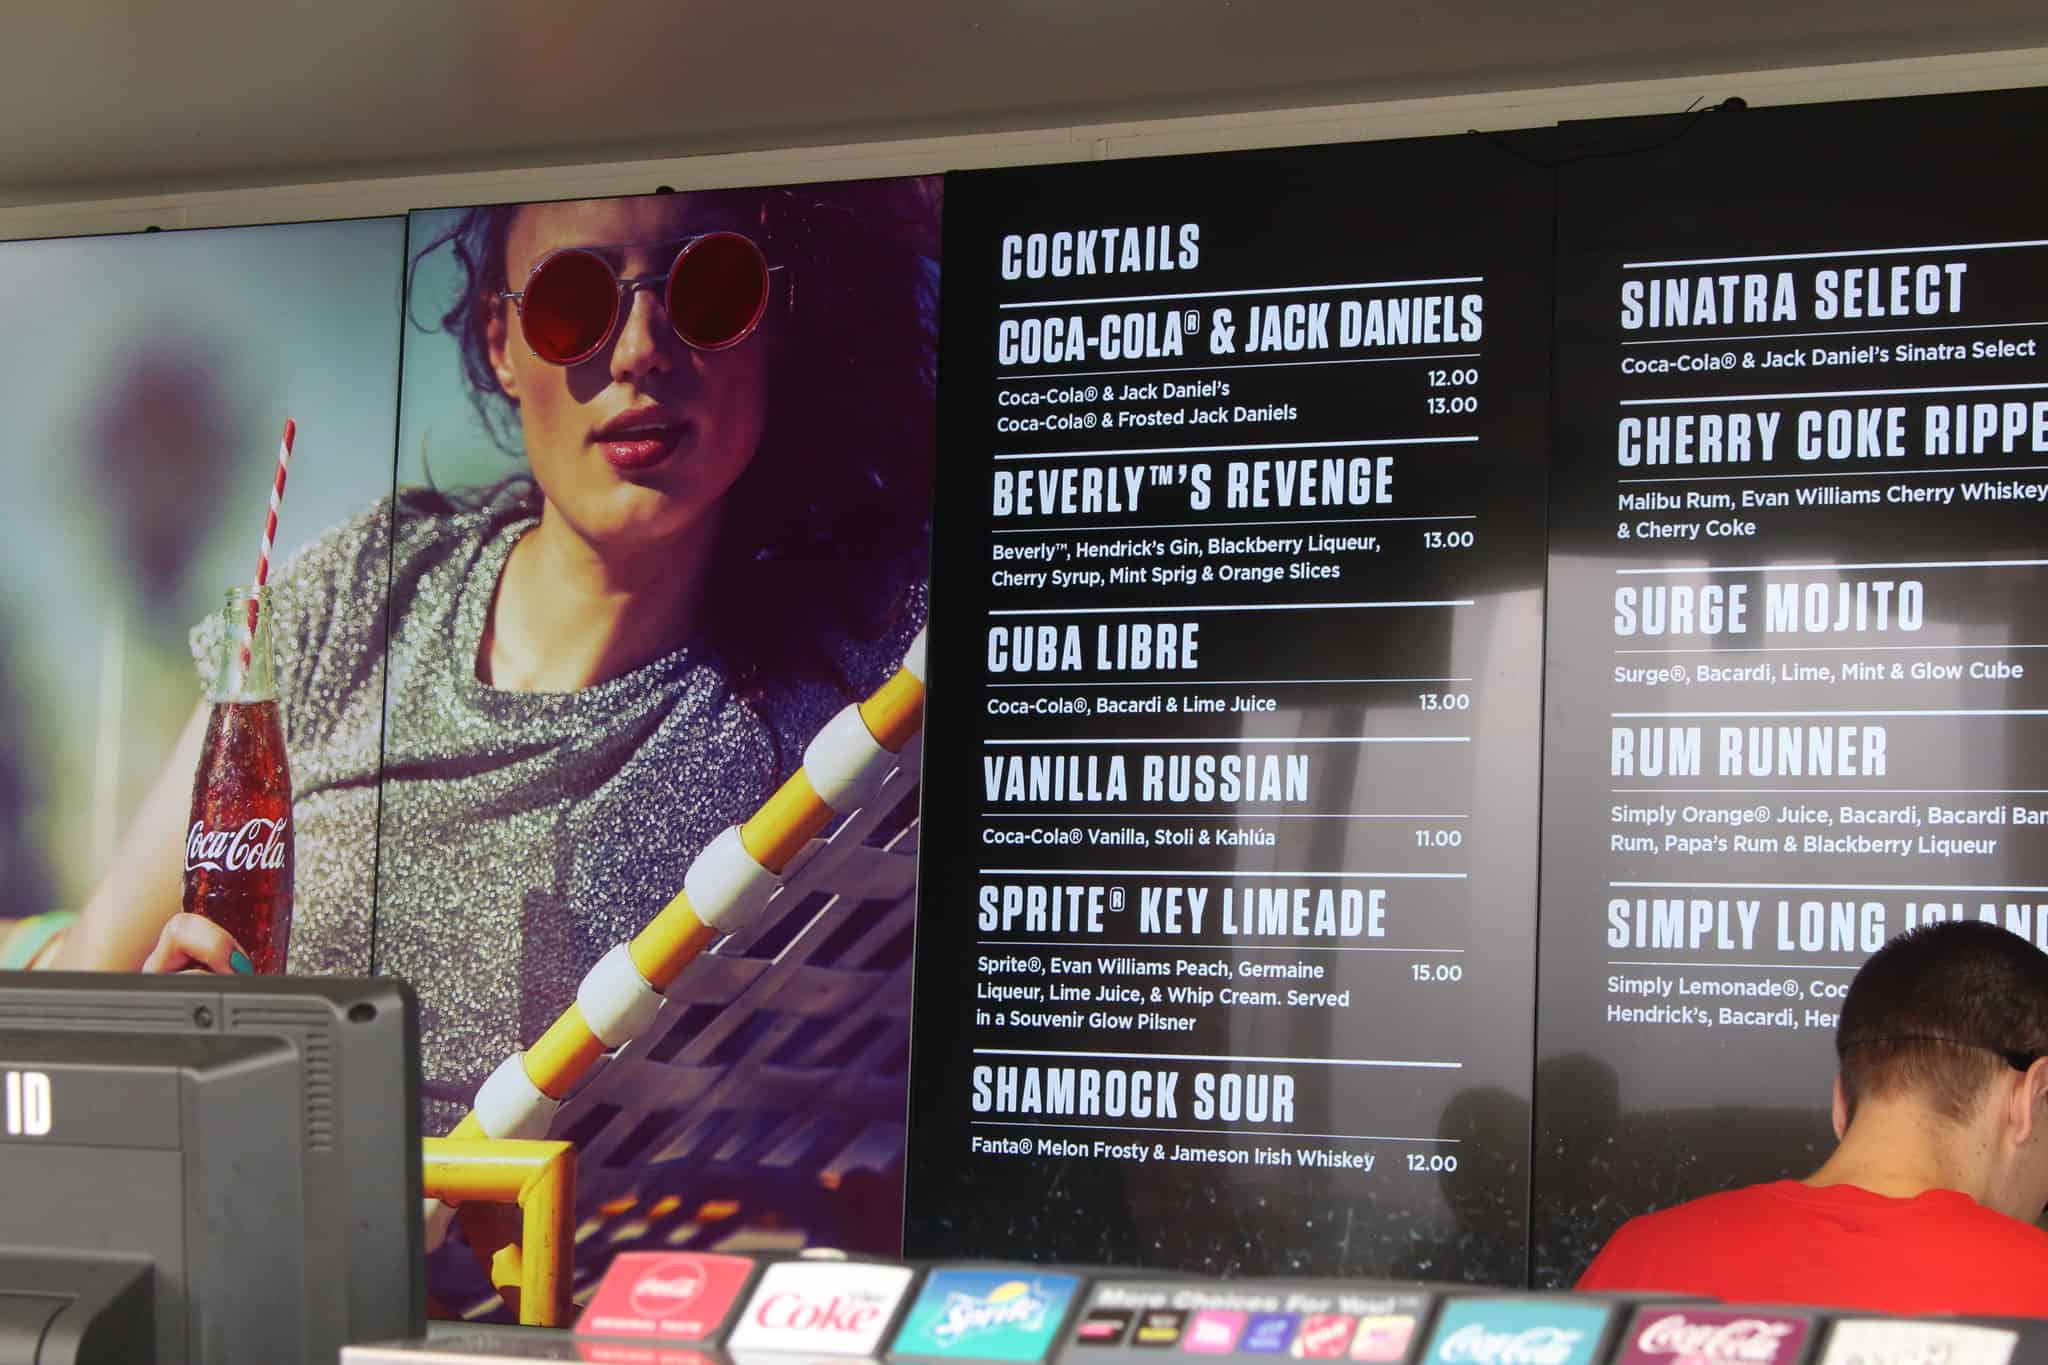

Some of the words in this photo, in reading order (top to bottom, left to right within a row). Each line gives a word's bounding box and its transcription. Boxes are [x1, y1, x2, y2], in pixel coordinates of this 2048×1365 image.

[1002, 224, 1200, 280] COCKTAILS
[1622, 273, 1797, 330] SINATRA
[1815, 263, 1967, 320] SELECT
[1210, 309, 1236, 355] &
[1245, 303, 1331, 353] JACK
[1340, 295, 1483, 348] DANIELS
[1622, 353, 1737, 374] Coca-Cola®
[1742, 352, 1755, 369] &
[1761, 350, 1806, 368] Jack
[1813, 346, 1889, 366] Daniel's
[1896, 344, 1966, 362] Sinatra
[1973, 340, 2036, 359] Select
[1429, 369, 1479, 387] 12.00
[999, 386, 1098, 406] Coca-Cola®
[1103, 386, 1115, 401] &
[1119, 384, 1158, 401] Jack
[1164, 381, 1230, 399] Daniel's
[1428, 397, 1478, 415] 13.00
[998, 413, 1097, 433] Coca-Cola®
[1102, 413, 1113, 428] &
[1119, 409, 1185, 428] Frosted
[1189, 407, 1229, 425] Jack
[1234, 404, 1297, 423] Daniels
[1619, 412, 1781, 467] CHERRY
[1798, 407, 1906, 461] COKE
[1926, 402, 2048, 456] RIPPE
[1228, 457, 1394, 509] REVENGE
[1619, 492, 1681, 511] Malibu
[1687, 493, 1736, 511] Rum,
[1743, 491, 1789, 507] Evan
[1796, 487, 1881, 506] Williams
[1887, 485, 1955, 505] Cherry
[1424, 532, 1474, 549] 13.00
[1617, 523, 1631, 539] &
[1637, 521, 1701, 541] Cherry
[1706, 519, 1756, 537] Coke
[1077, 540, 1165, 558] Hendrick's
[1170, 539, 1203, 558] Gin,
[1208, 537, 1303, 555] Blackberry
[1309, 535, 1381, 554] Liqueur,
[992, 571, 1048, 589] Cherry
[1052, 570, 1105, 588] Syrup,
[1110, 567, 1147, 584] Mint
[1152, 565, 1197, 586] Sprig
[1202, 566, 1214, 582] &
[1219, 566, 1285, 583] Orange
[1290, 562, 1341, 579] Slices
[1615, 585, 1747, 636] SURGE
[1766, 582, 1923, 633] MOJITO
[988, 626, 1082, 673] CUBA
[1098, 623, 1199, 670] LIBRE
[1615, 665, 1691, 686] Surge®,
[1697, 664, 1776, 684] Bacardi,
[1783, 664, 1836, 684] Lime,
[1843, 663, 1885, 681] Mint
[1891, 663, 1904, 680] &
[1911, 662, 1963, 680] Glow
[1970, 661, 2024, 679] Cube
[988, 698, 1091, 716] Coca-Cola®,
[1097, 696, 1162, 713] Bacardi
[1166, 697, 1178, 713] &
[1184, 696, 1226, 713] Lime
[1231, 695, 1277, 713] Juice
[1420, 694, 1470, 711] 13.00
[1612, 728, 1701, 777] RUM
[1720, 727, 1887, 777] RUNNER
[984, 756, 1128, 802] VANILLA
[1143, 754, 1309, 803] RUSSIAN
[1612, 805, 1677, 826] Simply
[1683, 806, 1771, 826] Orange®
[1777, 806, 1833, 827] Juice,
[1840, 806, 1921, 827] Bacardi,
[1928, 806, 2006, 825] Bacardi
[184, 817, 287, 871] Coca-Cola
[983, 828, 1083, 845] Coca-Cola®
[1088, 828, 1150, 848] Vanilla,
[1155, 828, 1194, 845] Stoli
[1199, 830, 1211, 845] &
[1216, 828, 1276, 846] Kahlúa
[1416, 831, 1462, 847] 11.00
[1612, 835, 1659, 855] Rum,
[1666, 835, 1728, 855] Papa's
[1734, 835, 1778, 852] Rum
[1784, 836, 1798, 852] &
[1804, 835, 1913, 857] Blackberry
[1919, 835, 1997, 857] Liqueur
[979, 886, 1126, 933] SPRITE®
[1141, 887, 1209, 934] KEY
[1223, 888, 1386, 937] LIMEADE
[1608, 899, 1761, 950] SIMPLY
[1778, 901, 1886, 953] LONG
[978, 956, 1046, 976] Sprite®,
[1051, 958, 1092, 974] Evan
[1098, 958, 1171, 976] Williams
[1177, 960, 1233, 980] Peach,
[1239, 961, 1324, 979] Germaine
[1412, 965, 1463, 982] 15.00
[978, 982, 1045, 1003] Liqueur,
[1050, 984, 1091, 1001] Lime
[1096, 985, 1145, 1005] Juice,
[1150, 987, 1162, 1003] &
[1168, 987, 1214, 1007] Whip
[1220, 989, 1281, 1006] Cream.
[1288, 990, 1350, 1007] Served
[1608, 976, 1673, 998] Simply
[1680, 978, 1804, 1001] Lemonade®,
[977, 1009, 991, 1025] in
[996, 1014, 1005, 1026] a
[1011, 1011, 1085, 1028] Souvenir
[1089, 1012, 1133, 1029] Glow
[1139, 1013, 1197, 1031] Pilsner
[1608, 1005, 1713, 1028] Hendrick's,
[1720, 1008, 1799, 1030] Bacardi,
[6, 1071, 52, 1136] ID
[972, 1066, 1179, 1119] SHAMROCK
[1195, 1073, 1295, 1123] SOUR
[973, 1137, 1033, 1155] Fanta®
[1038, 1140, 1089, 1157] Melon
[1094, 1142, 1150, 1163] Frosty
[1153, 1144, 1165, 1160] &
[1171, 1145, 1249, 1164] Jameson
[1255, 1148, 1292, 1166] Irish
[1297, 1150, 1375, 1172] Whiskey
[1407, 1154, 1458, 1172] 12.00
[755, 1291, 879, 1333] Coke
